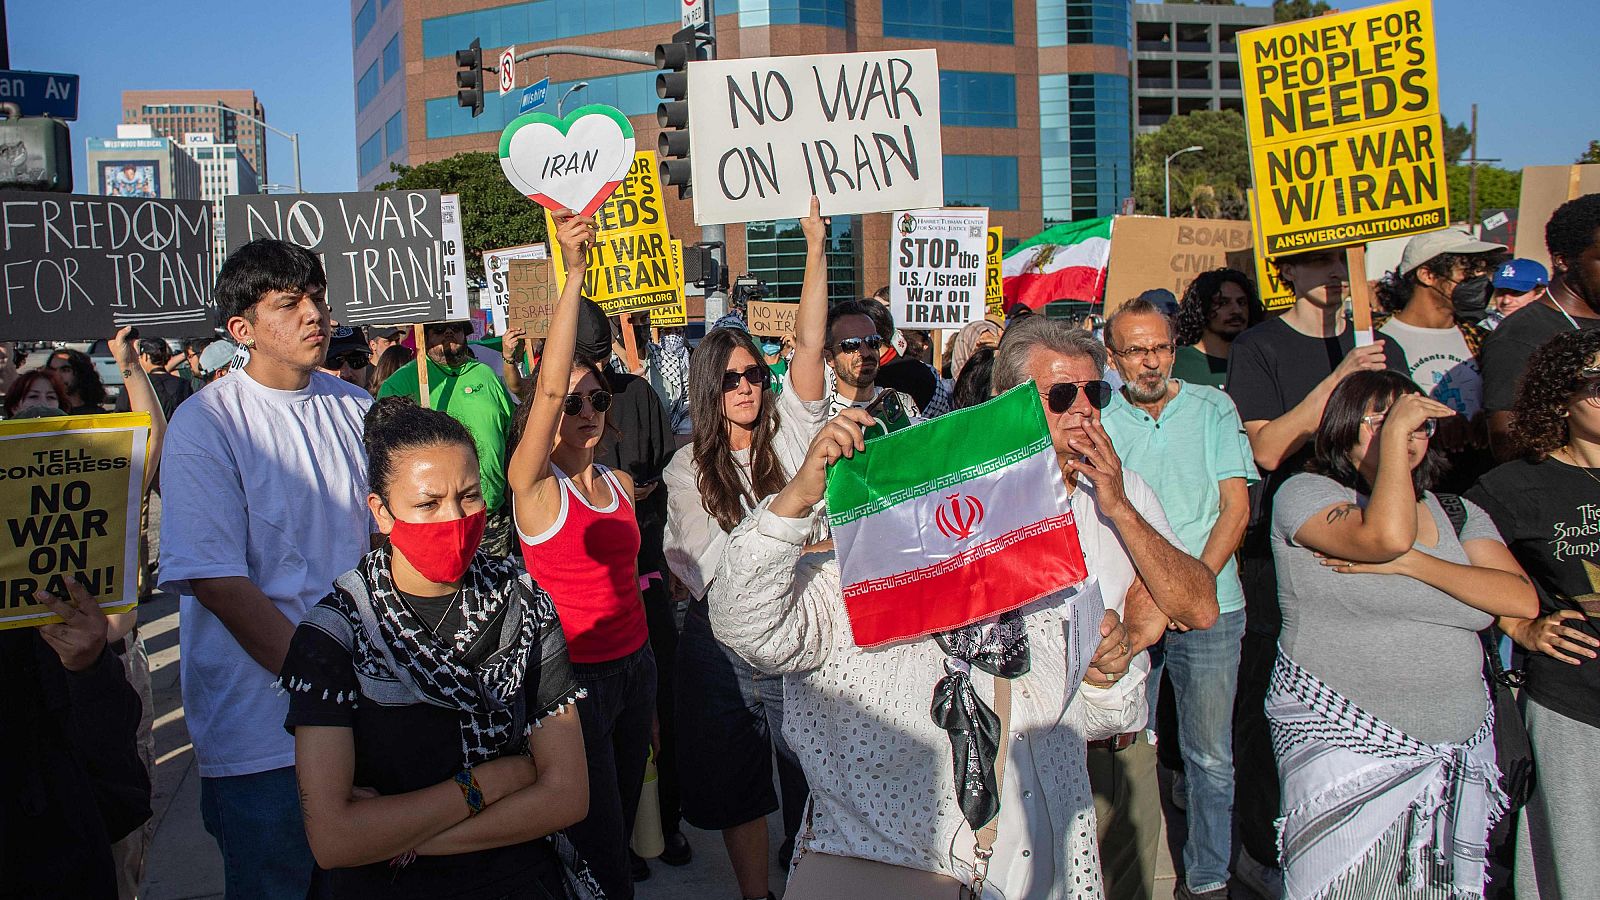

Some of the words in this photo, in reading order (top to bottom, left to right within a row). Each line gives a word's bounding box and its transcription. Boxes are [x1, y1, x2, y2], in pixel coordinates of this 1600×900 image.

[1254, 22, 1356, 63] MONEY
[1366, 9, 1422, 42] FOR
[1257, 36, 1425, 94] PEOPLE'S
[45, 76, 71, 100] Av
[522, 88, 546, 107] Wilshire
[727, 70, 794, 129] NO
[812, 58, 922, 122] WAR
[1260, 68, 1429, 138] NEEDS
[541, 149, 598, 180] IRAN
[718, 142, 780, 200] ON
[801, 125, 919, 195] IRAN
[1267, 140, 1339, 186] NOT
[1347, 124, 1434, 172] WAR
[1334, 162, 1438, 217] IRAN
[339, 192, 434, 244] WAR
[1275, 212, 1440, 249] ANSWERCOALITION.ORG
[610, 233, 666, 264] WAR
[899, 238, 959, 269] STOP
[958, 251, 980, 269] the
[4, 257, 94, 315] FOR
[106, 252, 214, 309] IRAN!
[342, 240, 443, 305] IRAN!
[604, 258, 671, 294] IRAN
[934, 272, 977, 286] Israeli
[752, 306, 770, 318] NO
[907, 288, 943, 302] War
[948, 290, 970, 302] on
[753, 320, 771, 331] ON
[905, 304, 970, 323] IRAN!
[33, 448, 92, 464] TELL
[30, 480, 91, 516] NO
[1576, 503, 1600, 525] The
[7, 509, 109, 548] WAR
[1548, 522, 1600, 544] Smas
[29, 541, 88, 575] ON
[1553, 540, 1600, 562] Pump
